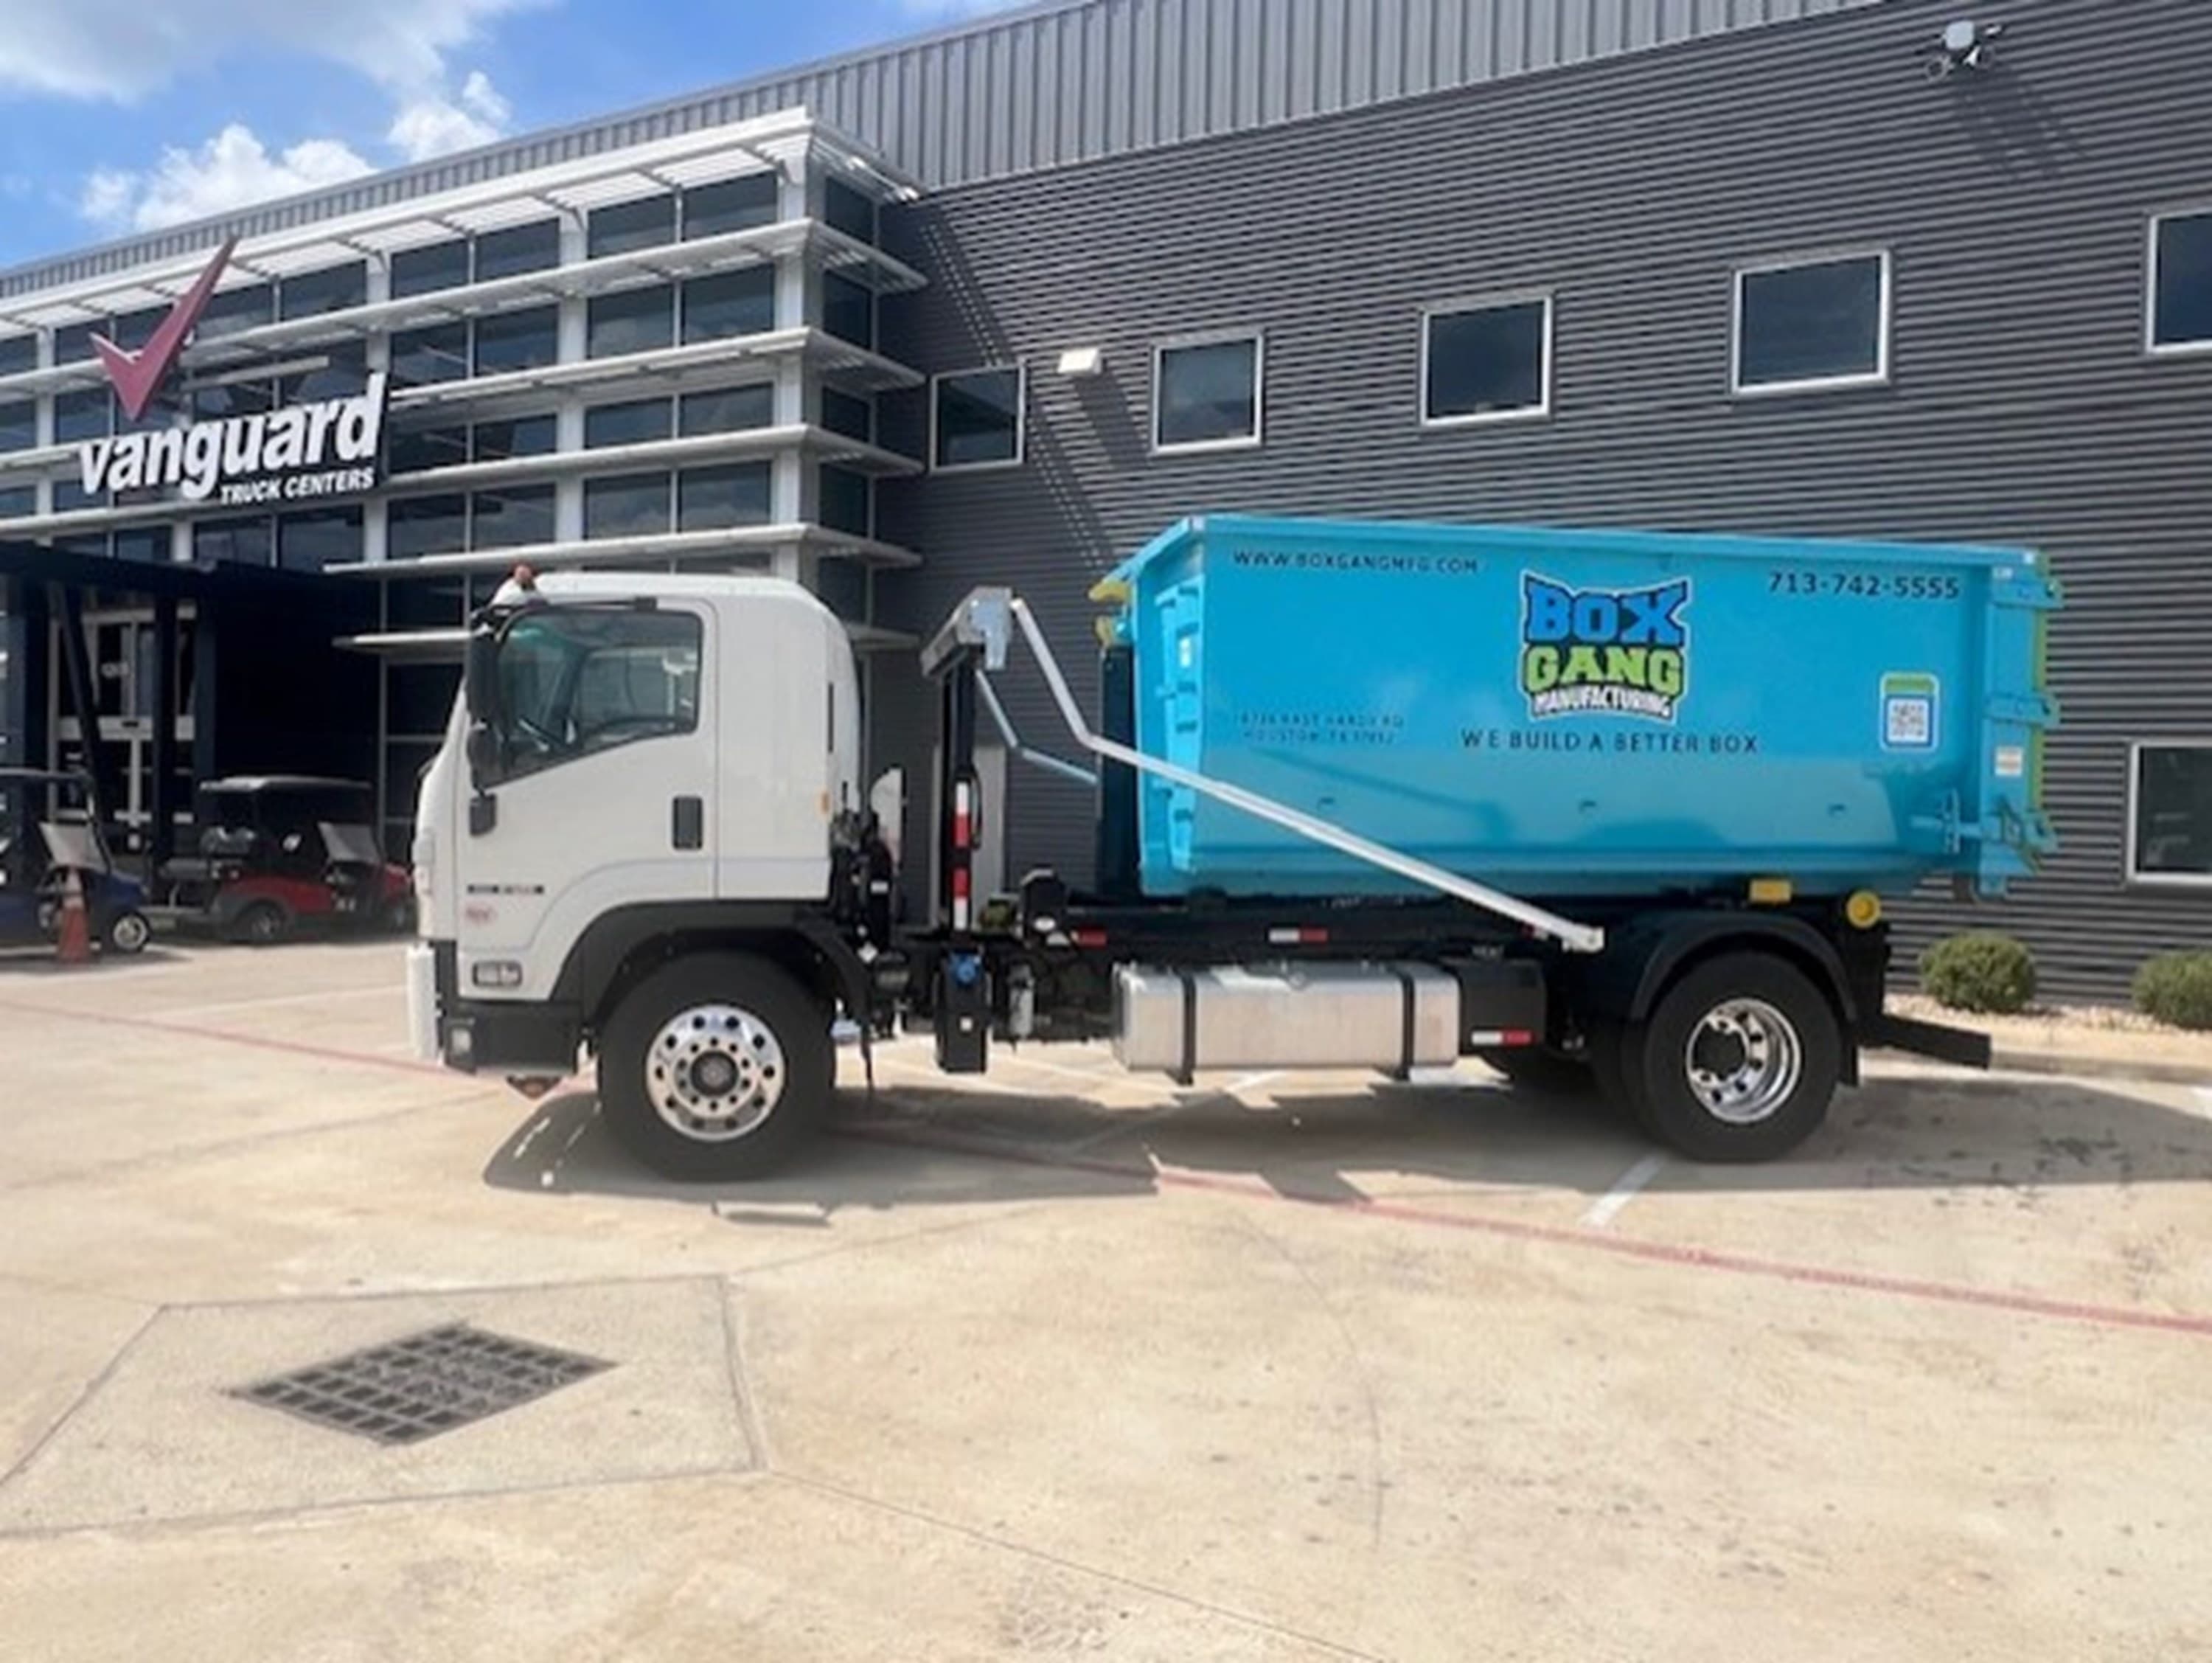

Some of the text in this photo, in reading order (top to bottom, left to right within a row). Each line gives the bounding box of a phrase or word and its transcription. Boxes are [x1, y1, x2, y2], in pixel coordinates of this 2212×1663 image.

[79, 371, 386, 499] vanguard
[220, 468, 375, 505] TRUCK CENTERS
[1526, 577, 1687, 646] BOX
[1769, 572, 1960, 600] 713-742-5555
[1526, 645, 1683, 713] GANG
[1461, 729, 1758, 754] WE BUILD A BETTER BOX
